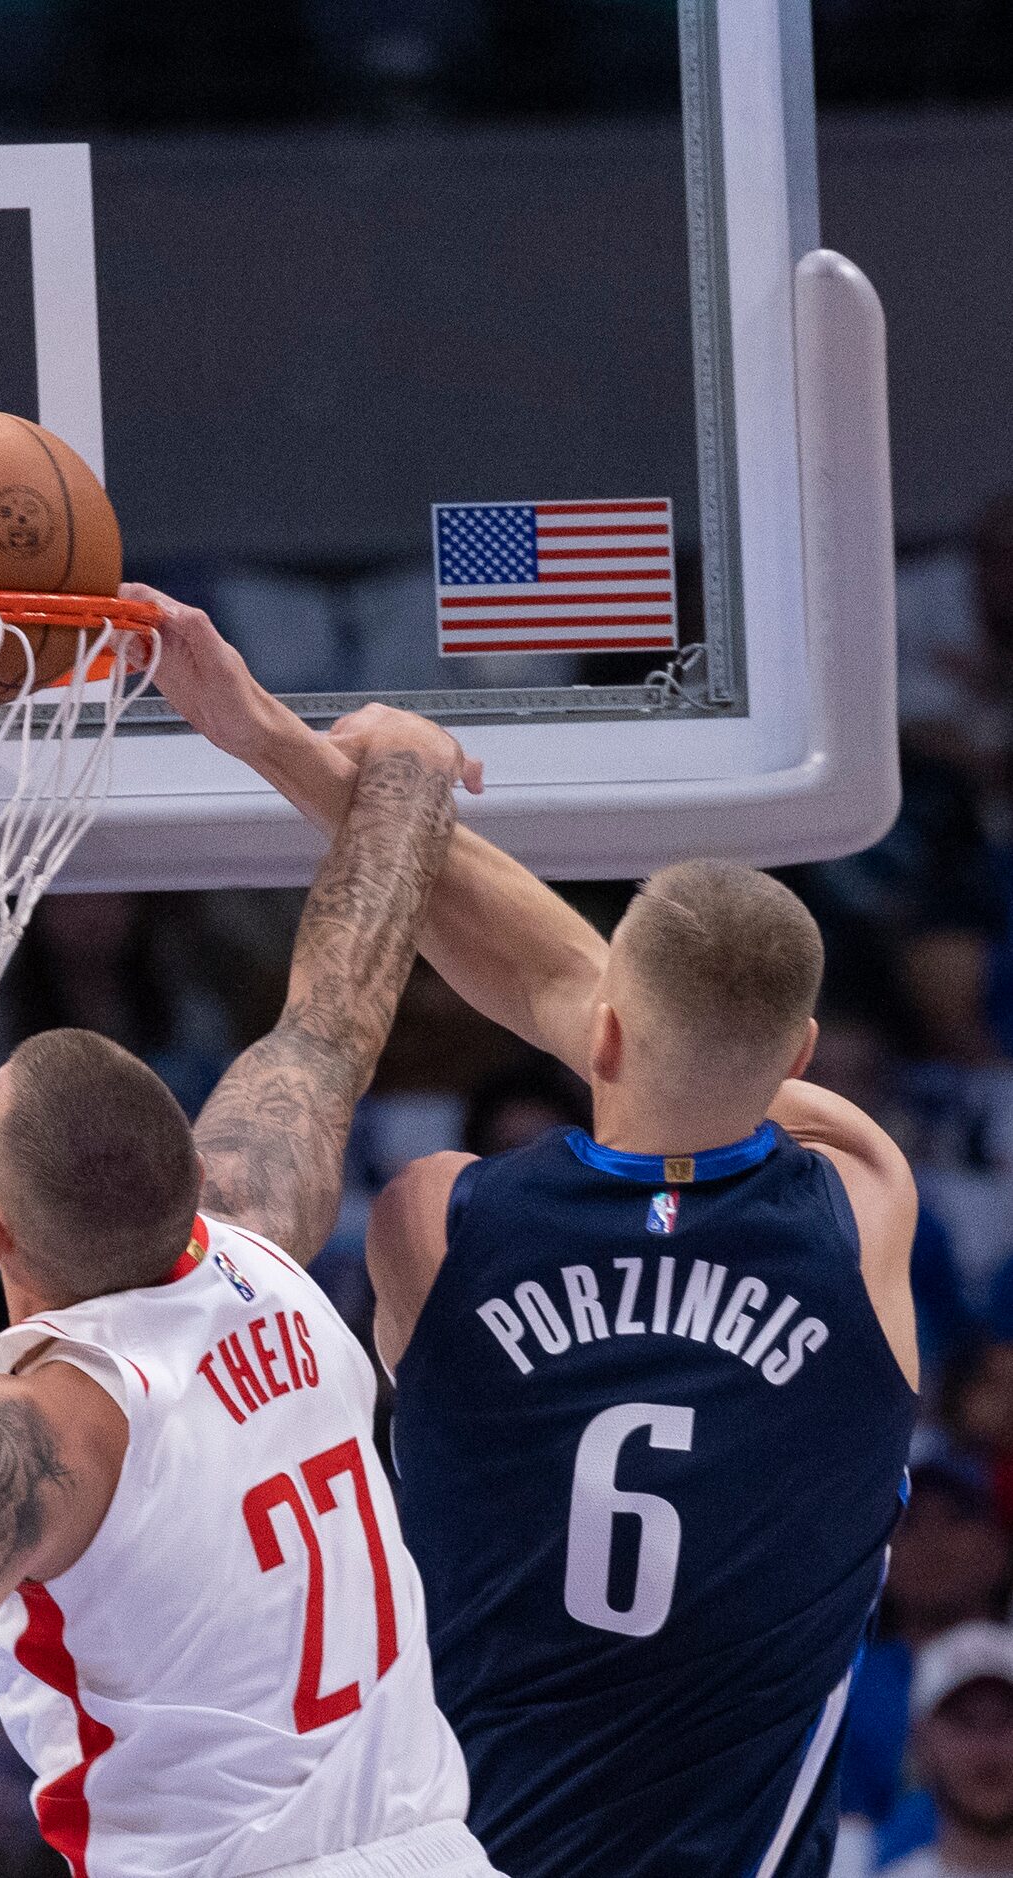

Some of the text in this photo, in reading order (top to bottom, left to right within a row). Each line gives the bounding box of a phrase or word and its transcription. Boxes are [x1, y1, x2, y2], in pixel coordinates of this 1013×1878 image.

[196, 1310, 319, 1425] THEIS
[476, 1256, 830, 1386] PORZINGIS
[241, 1437, 399, 1734] 27
[564, 1402, 695, 1637] 6
